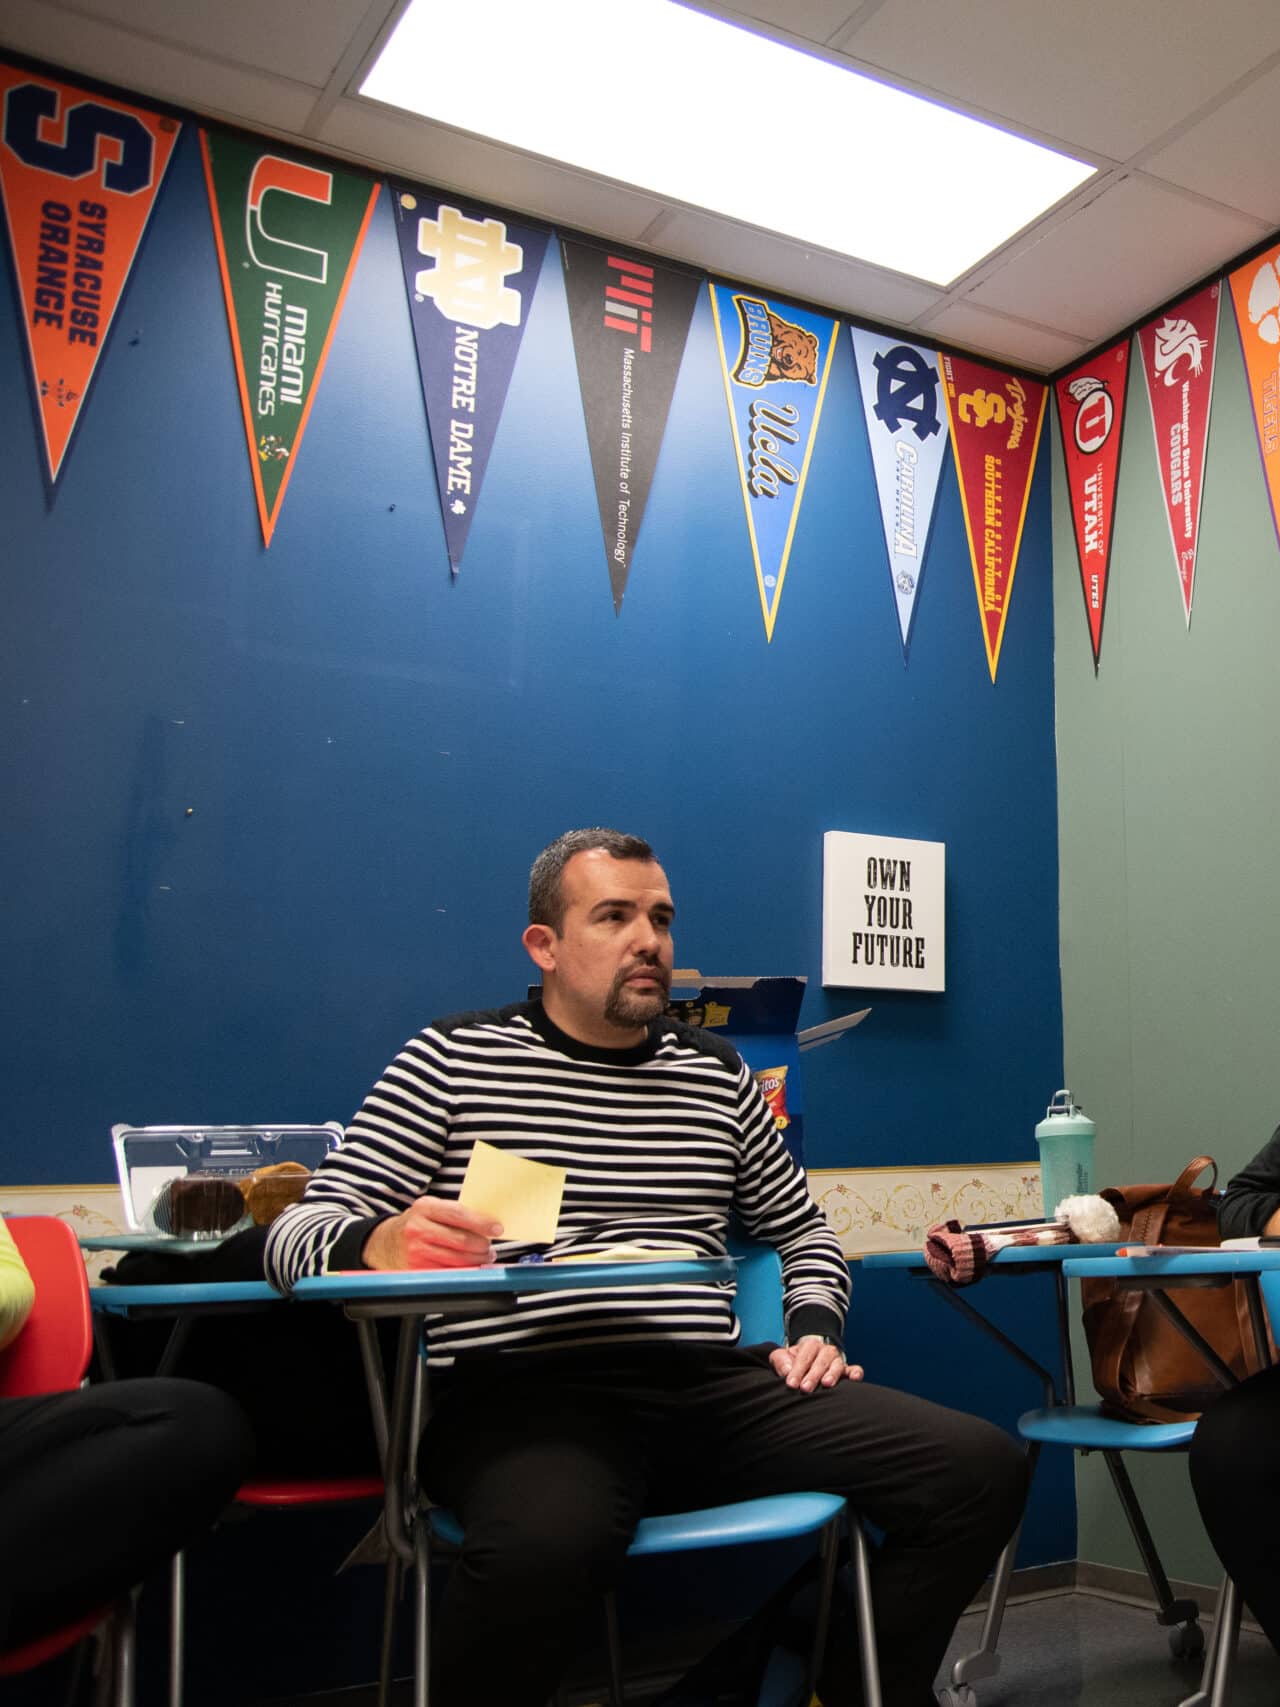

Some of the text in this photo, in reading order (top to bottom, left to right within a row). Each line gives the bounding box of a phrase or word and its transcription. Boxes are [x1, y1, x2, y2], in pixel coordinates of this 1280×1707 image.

[33, 200, 73, 330] ORANGE
[69, 199, 107, 347] SYRACUSE
[738, 299, 773, 385] BRUINS
[447, 326, 479, 495] NOTRE DAME
[1005, 377, 1028, 449] Trojans
[1182, 380, 1191, 446] Washington
[1262, 371, 1279, 455] TIGERS
[614, 348, 635, 566] Massachusetts Institute of Technology
[1170, 423, 1182, 506] COUGARS
[1183, 447, 1191, 478] State
[894, 440, 918, 560] CAROLINA
[985, 454, 996, 611] SOUTHERN CALIFORNIA
[1084, 473, 1098, 553] UTAH
[1183, 479, 1192, 538] University
[1091, 574, 1099, 609] UTES
[864, 895, 913, 930] YOUR
[867, 857, 911, 892] OWN
[852, 932, 925, 969] FUTURE
